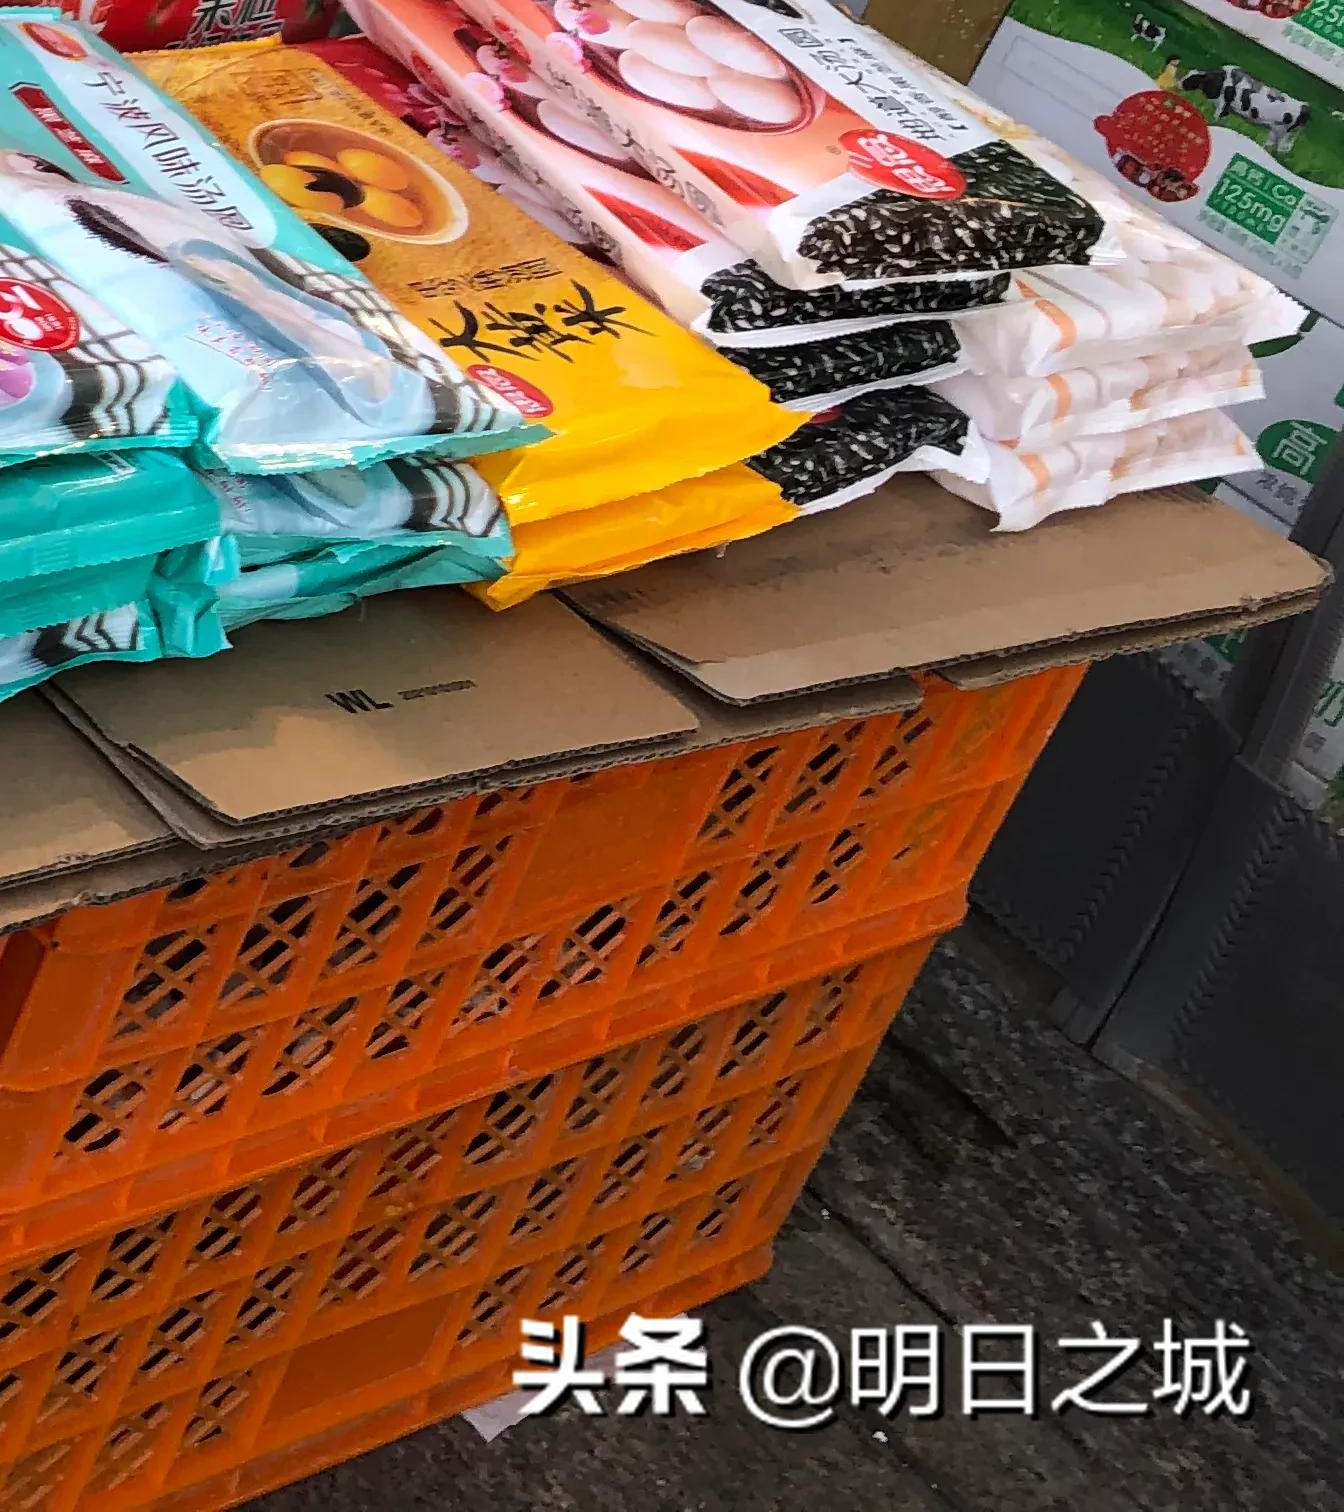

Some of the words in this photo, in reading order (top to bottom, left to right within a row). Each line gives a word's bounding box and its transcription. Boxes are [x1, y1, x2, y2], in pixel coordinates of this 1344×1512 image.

[83, 71, 254, 232] 宁波风味汤圆
[1217, 178, 1287, 233] 125mg
[427, 279, 657, 364] 大黄米
[1273, 421, 1328, 476] 高
